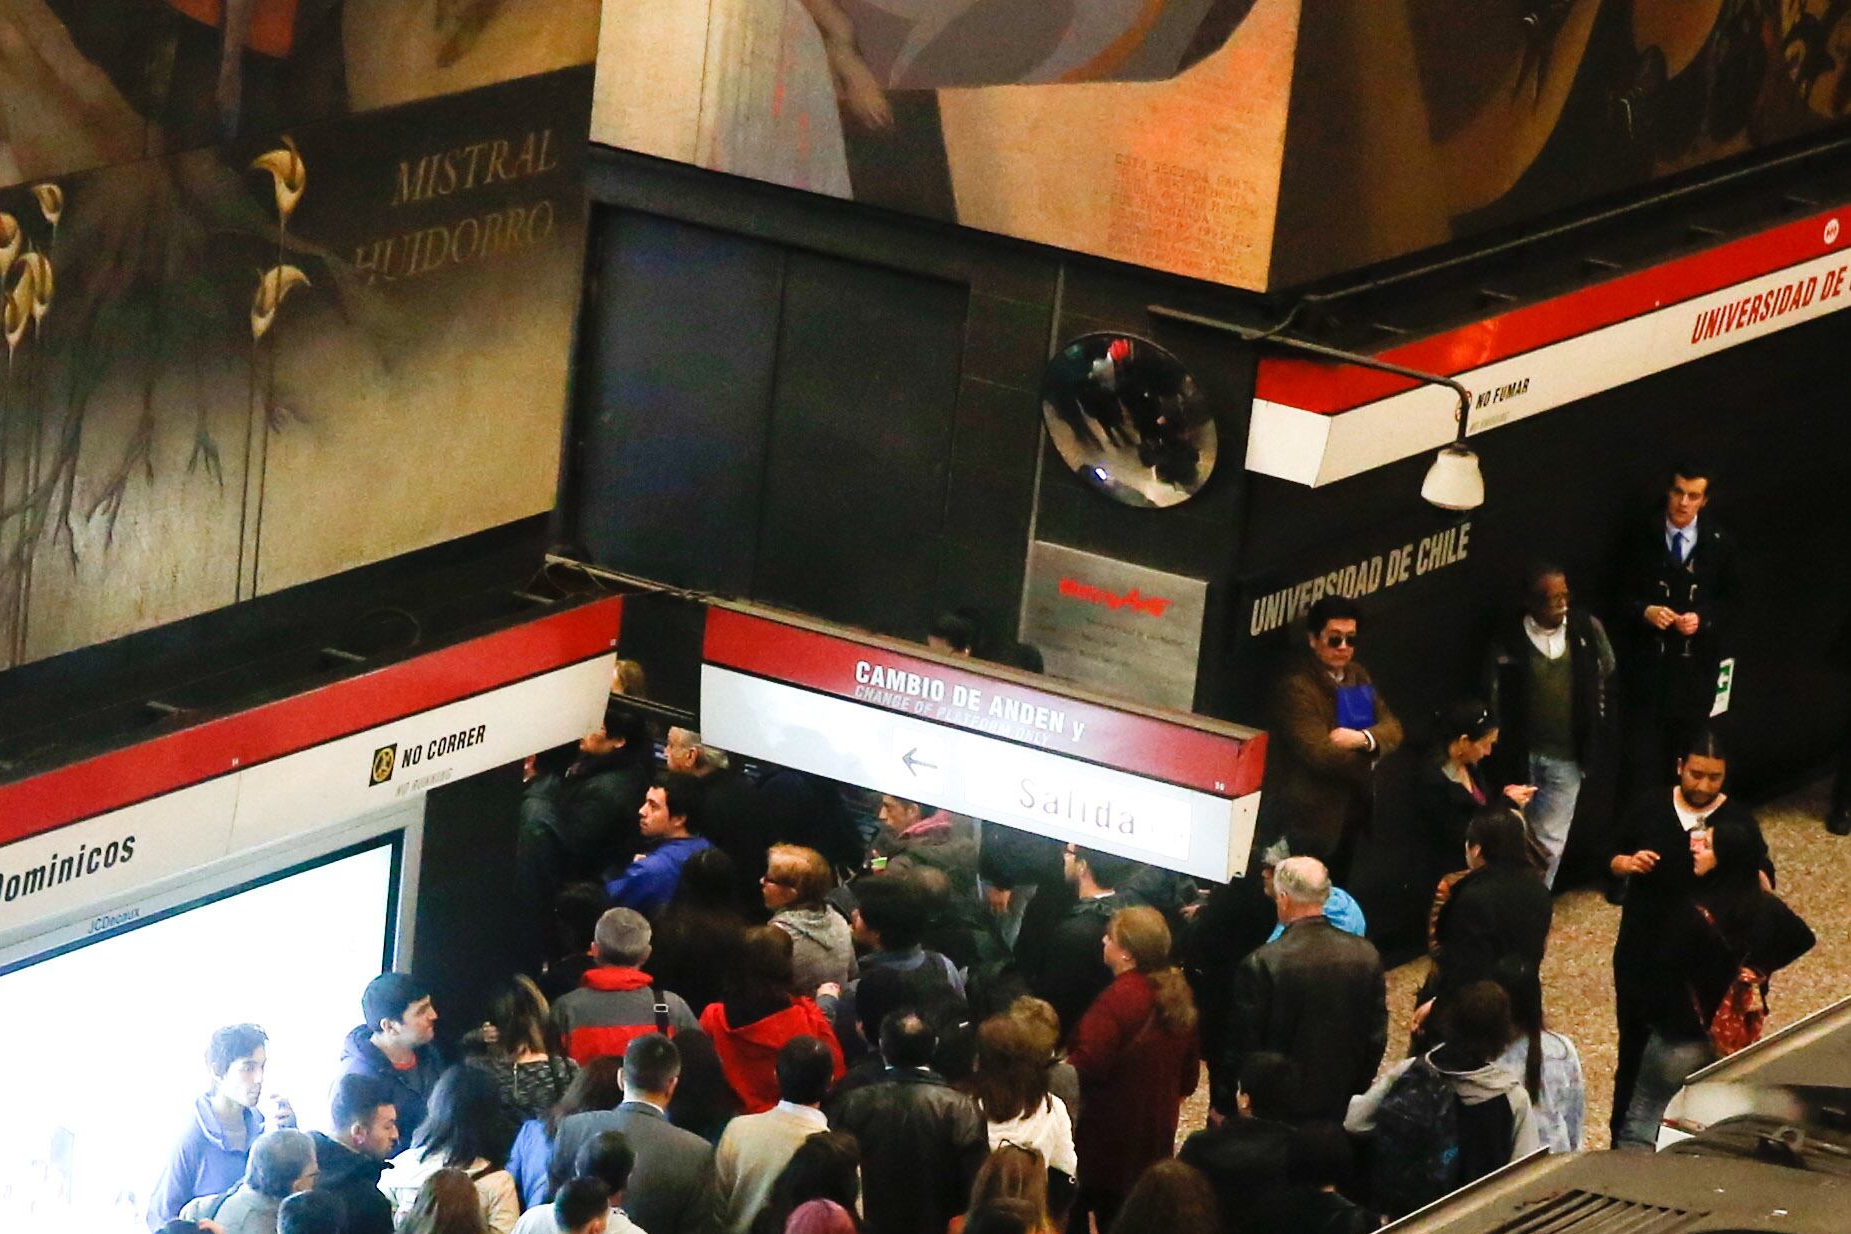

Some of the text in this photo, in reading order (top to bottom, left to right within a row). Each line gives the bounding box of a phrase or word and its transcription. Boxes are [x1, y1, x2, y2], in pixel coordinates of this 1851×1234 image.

[391, 128, 558, 206] MISTRAL
[355, 200, 555, 285] HUIDOBRO
[1691, 265, 1848, 344] UNIVERSIDAD DE
[1475, 377, 1531, 411] NO FUMAR
[1251, 522, 1472, 636] UNIVERSIDAD DE CHILE
[853, 684, 911, 710] CHANGE
[913, 699, 934, 716] OF
[854, 659, 1087, 744] CAMBIO DE ANDEN y
[401, 724, 487, 769] NO CORRER
[1018, 777, 1136, 836] Salida
[87, 907, 140, 934] JCDecaux
